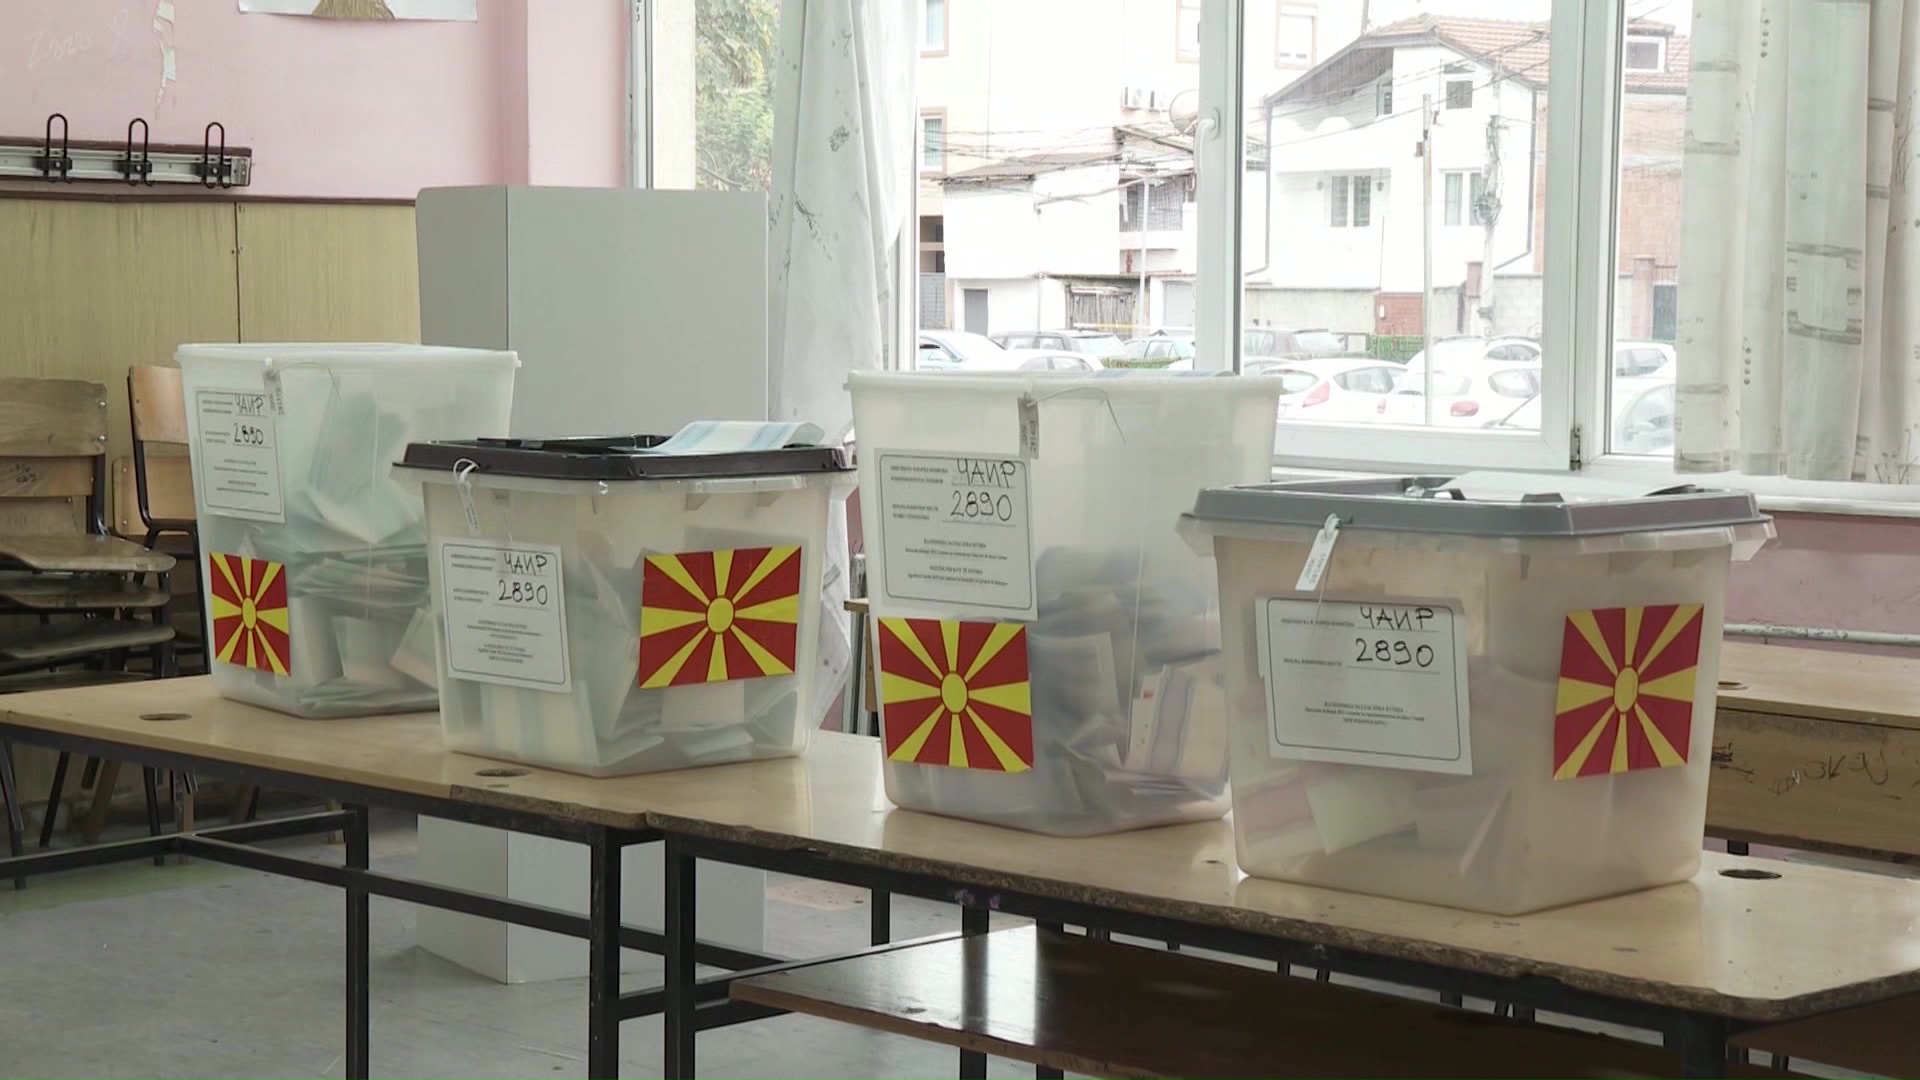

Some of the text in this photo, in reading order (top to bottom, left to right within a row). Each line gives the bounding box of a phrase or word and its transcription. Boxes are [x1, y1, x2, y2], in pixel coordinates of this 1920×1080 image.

[957, 458, 1016, 488] ЧАИР
[950, 490, 1012, 522] 2890
[504, 552, 548, 576] ЧАИР
[498, 579, 548, 605] 2890
[1360, 606, 1434, 631] ЧАИР
[1355, 637, 1434, 668] 2890
